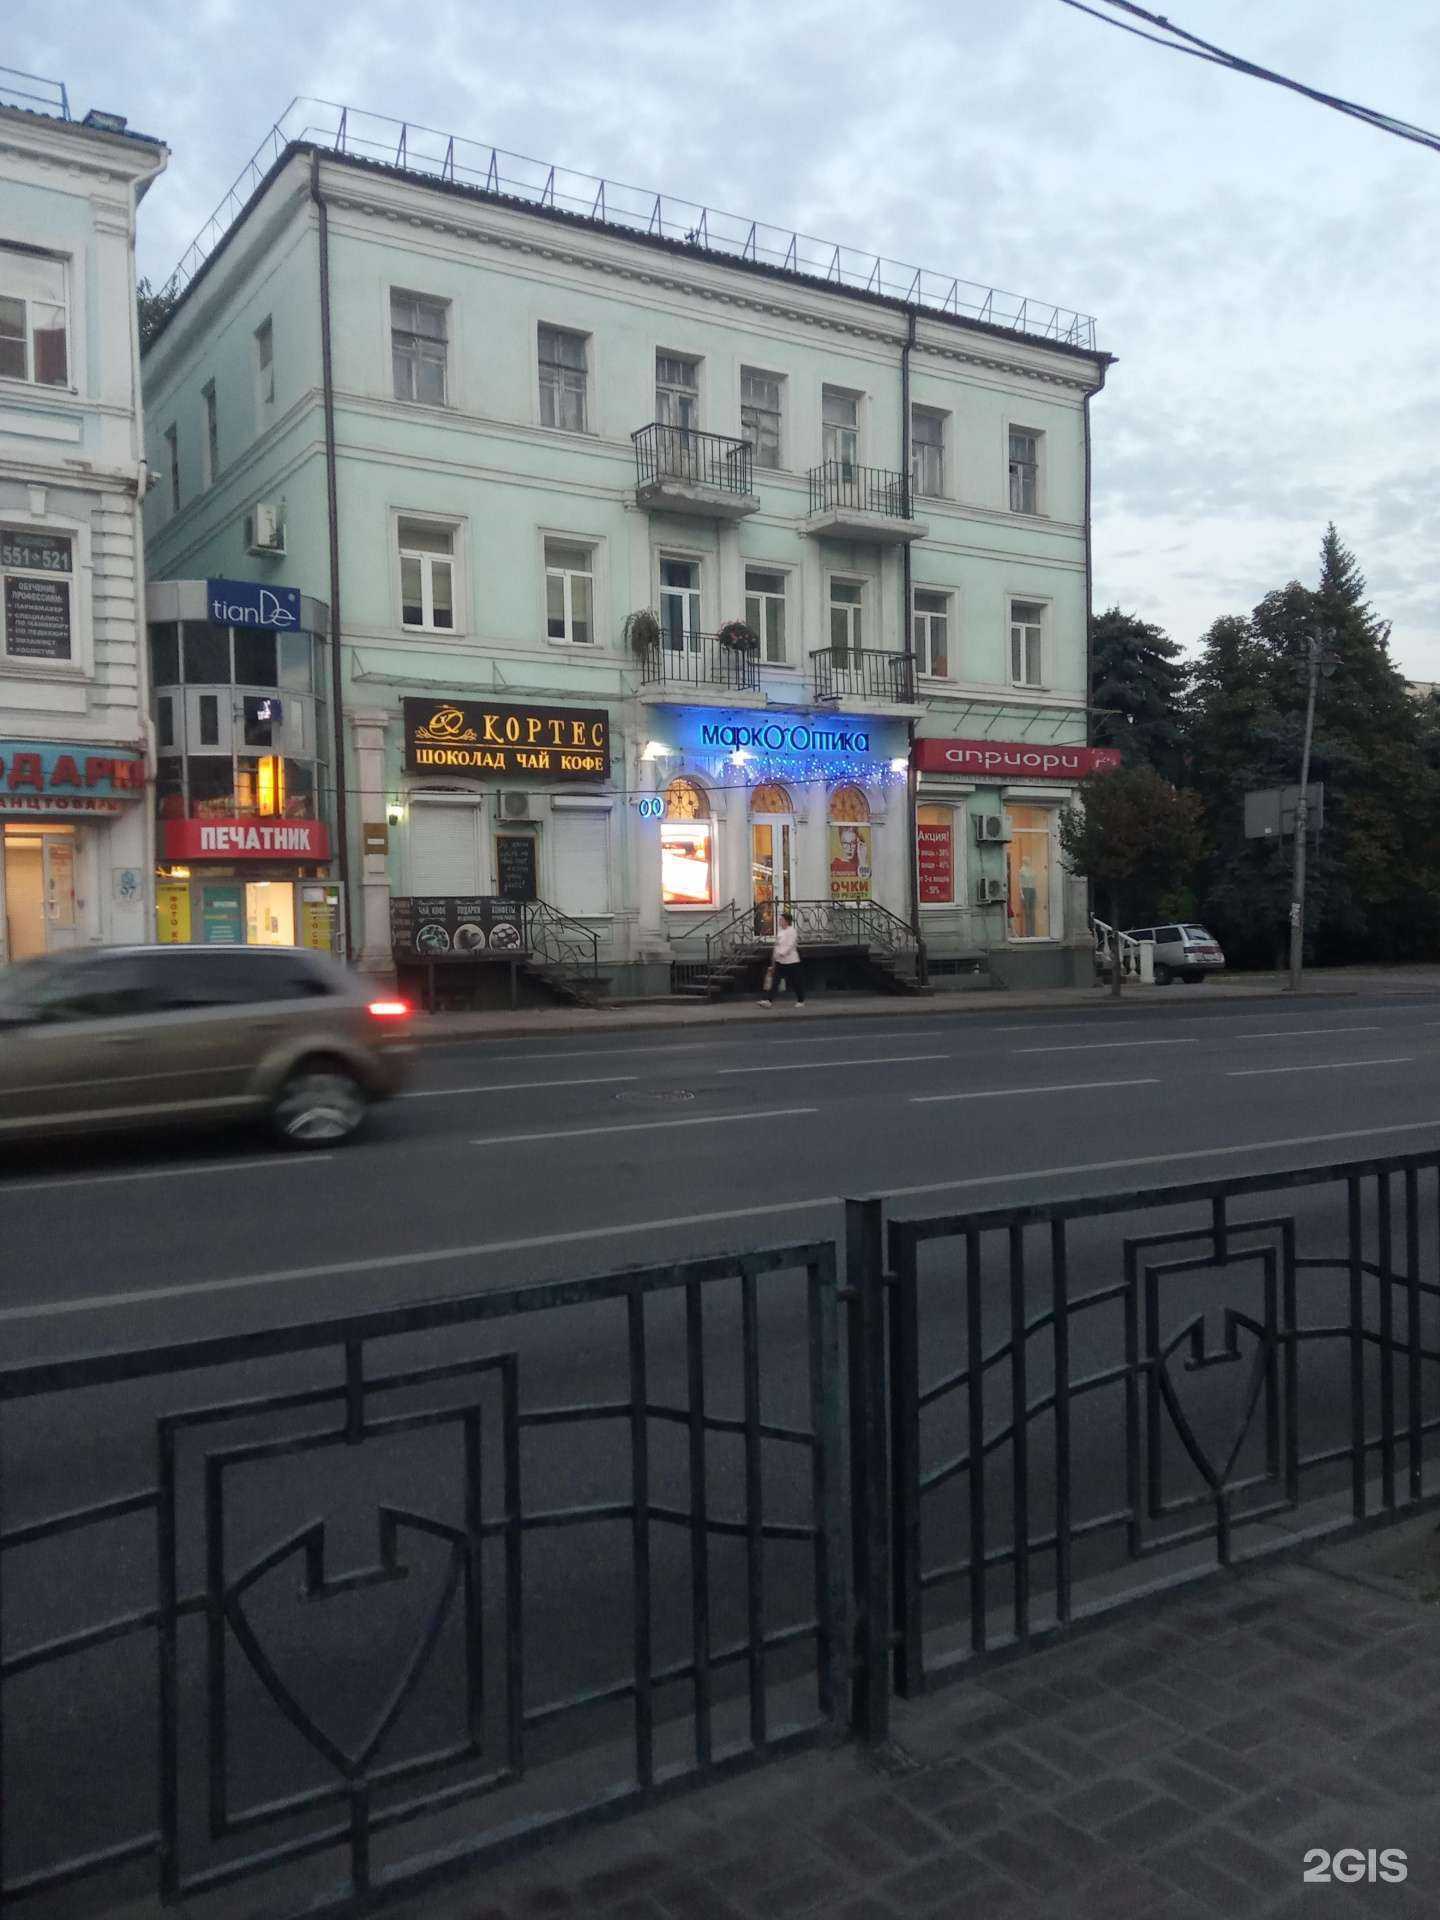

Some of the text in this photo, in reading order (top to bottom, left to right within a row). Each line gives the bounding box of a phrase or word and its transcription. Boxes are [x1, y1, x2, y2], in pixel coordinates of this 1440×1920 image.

[483, 714, 604, 747] КОРТЕС
[416, 748, 604, 772] ШОКОЛАД ЧАЙ КОФЕ
[201, 826, 311, 850] ПЕЧАТНИК
[919, 831, 950, 844] Акция!
[831, 880, 869, 893] ОЧКИ
